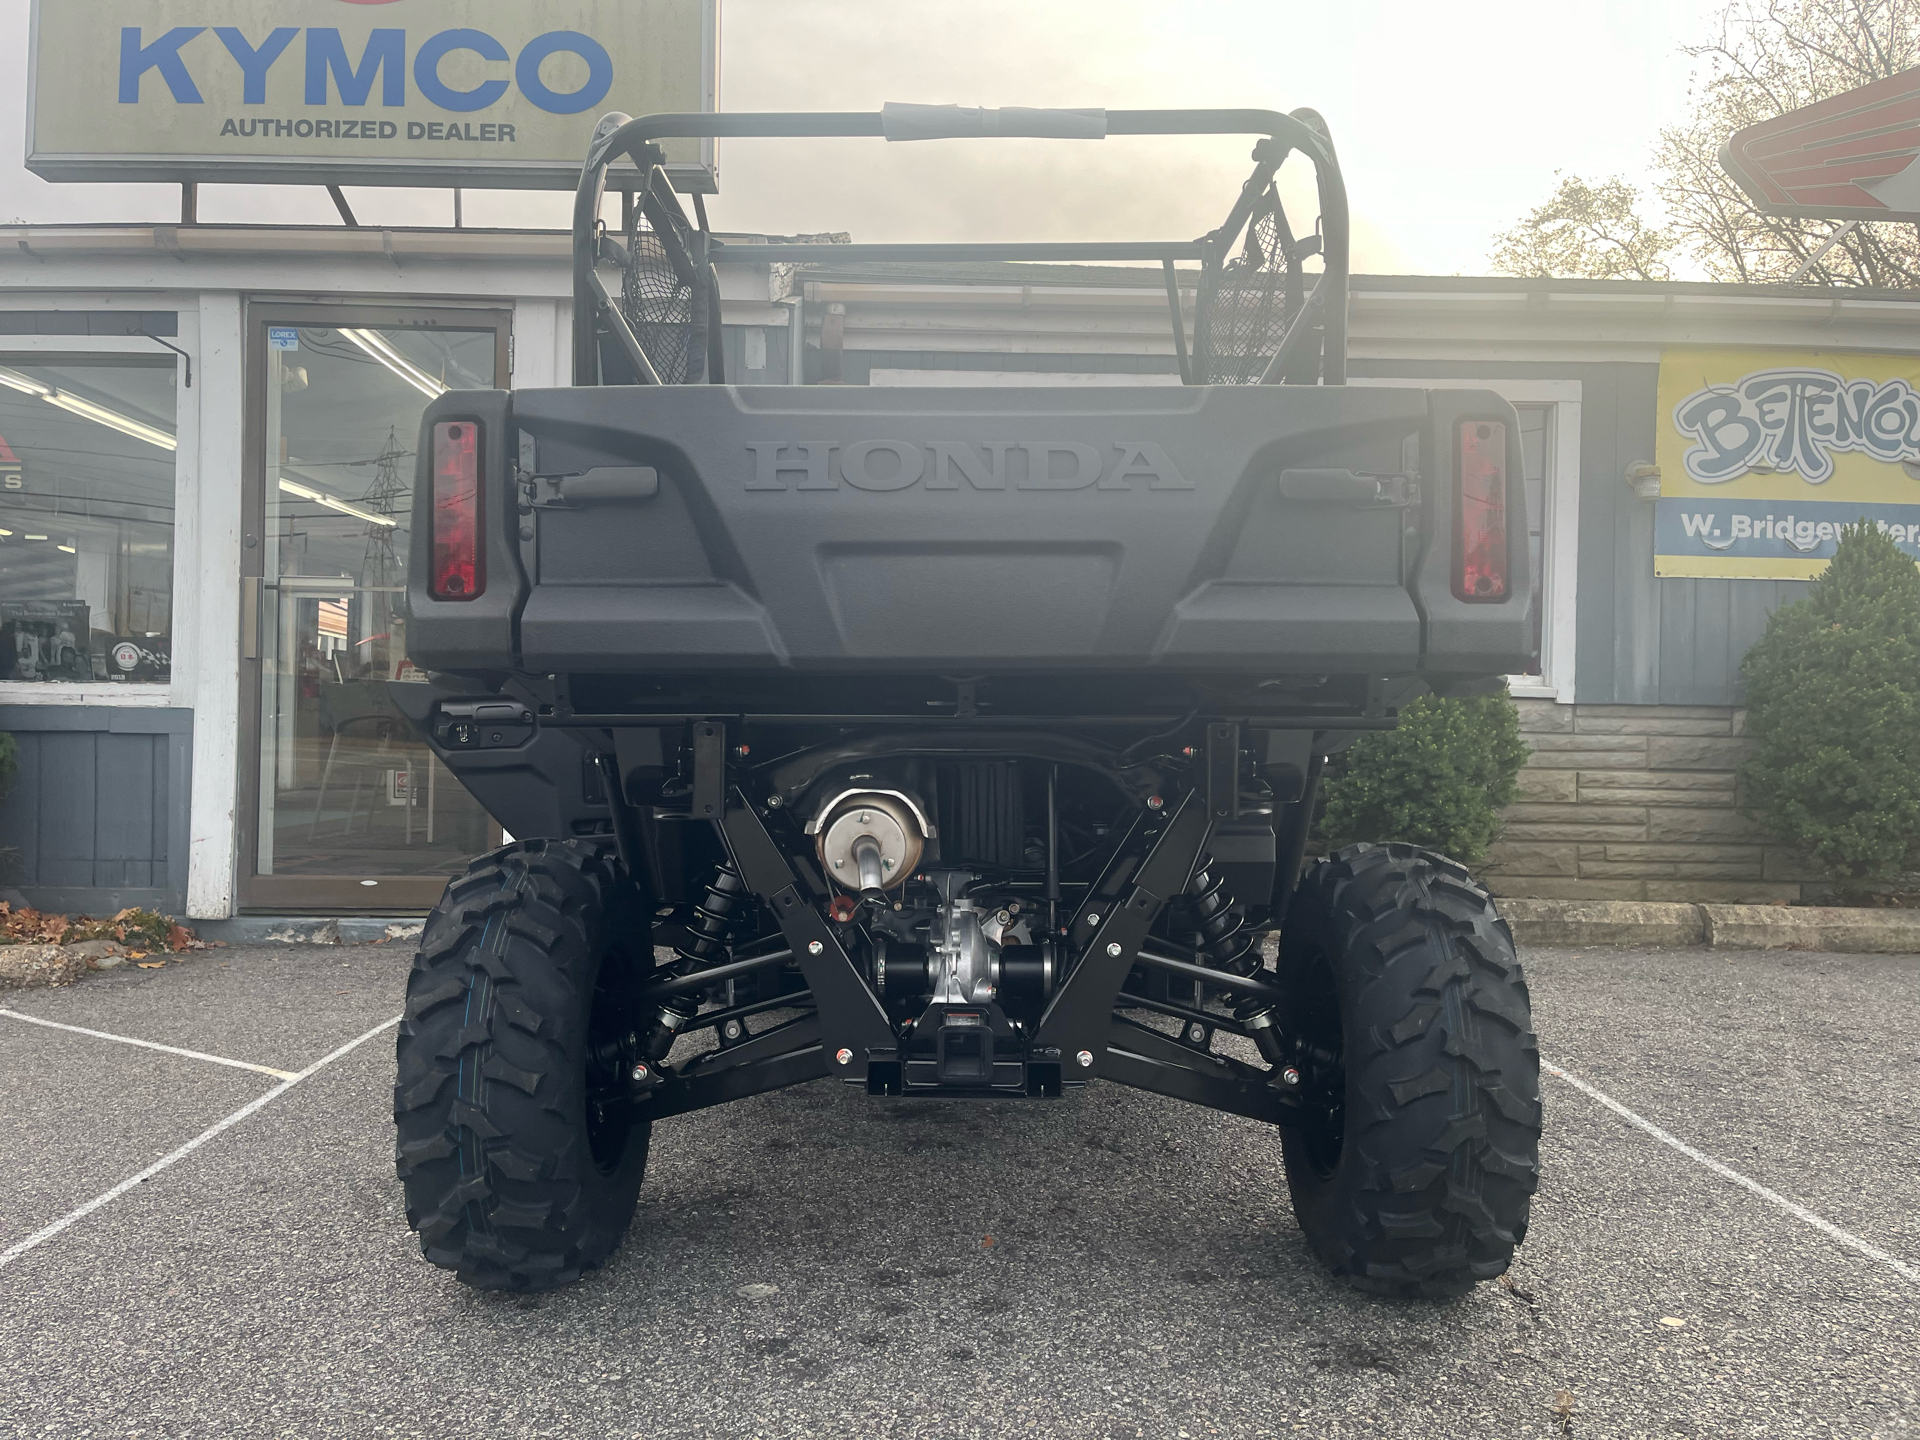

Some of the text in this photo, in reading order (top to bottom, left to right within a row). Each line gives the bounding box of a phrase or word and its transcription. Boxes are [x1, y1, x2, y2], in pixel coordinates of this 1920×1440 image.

[118, 26, 614, 115] KYMCO
[220, 118, 516, 142] AUTHORIZED DEALER
[271, 331, 296, 339] LOREX
[744, 439, 1196, 492] HONDA
[1681, 513, 1721, 537] W.
